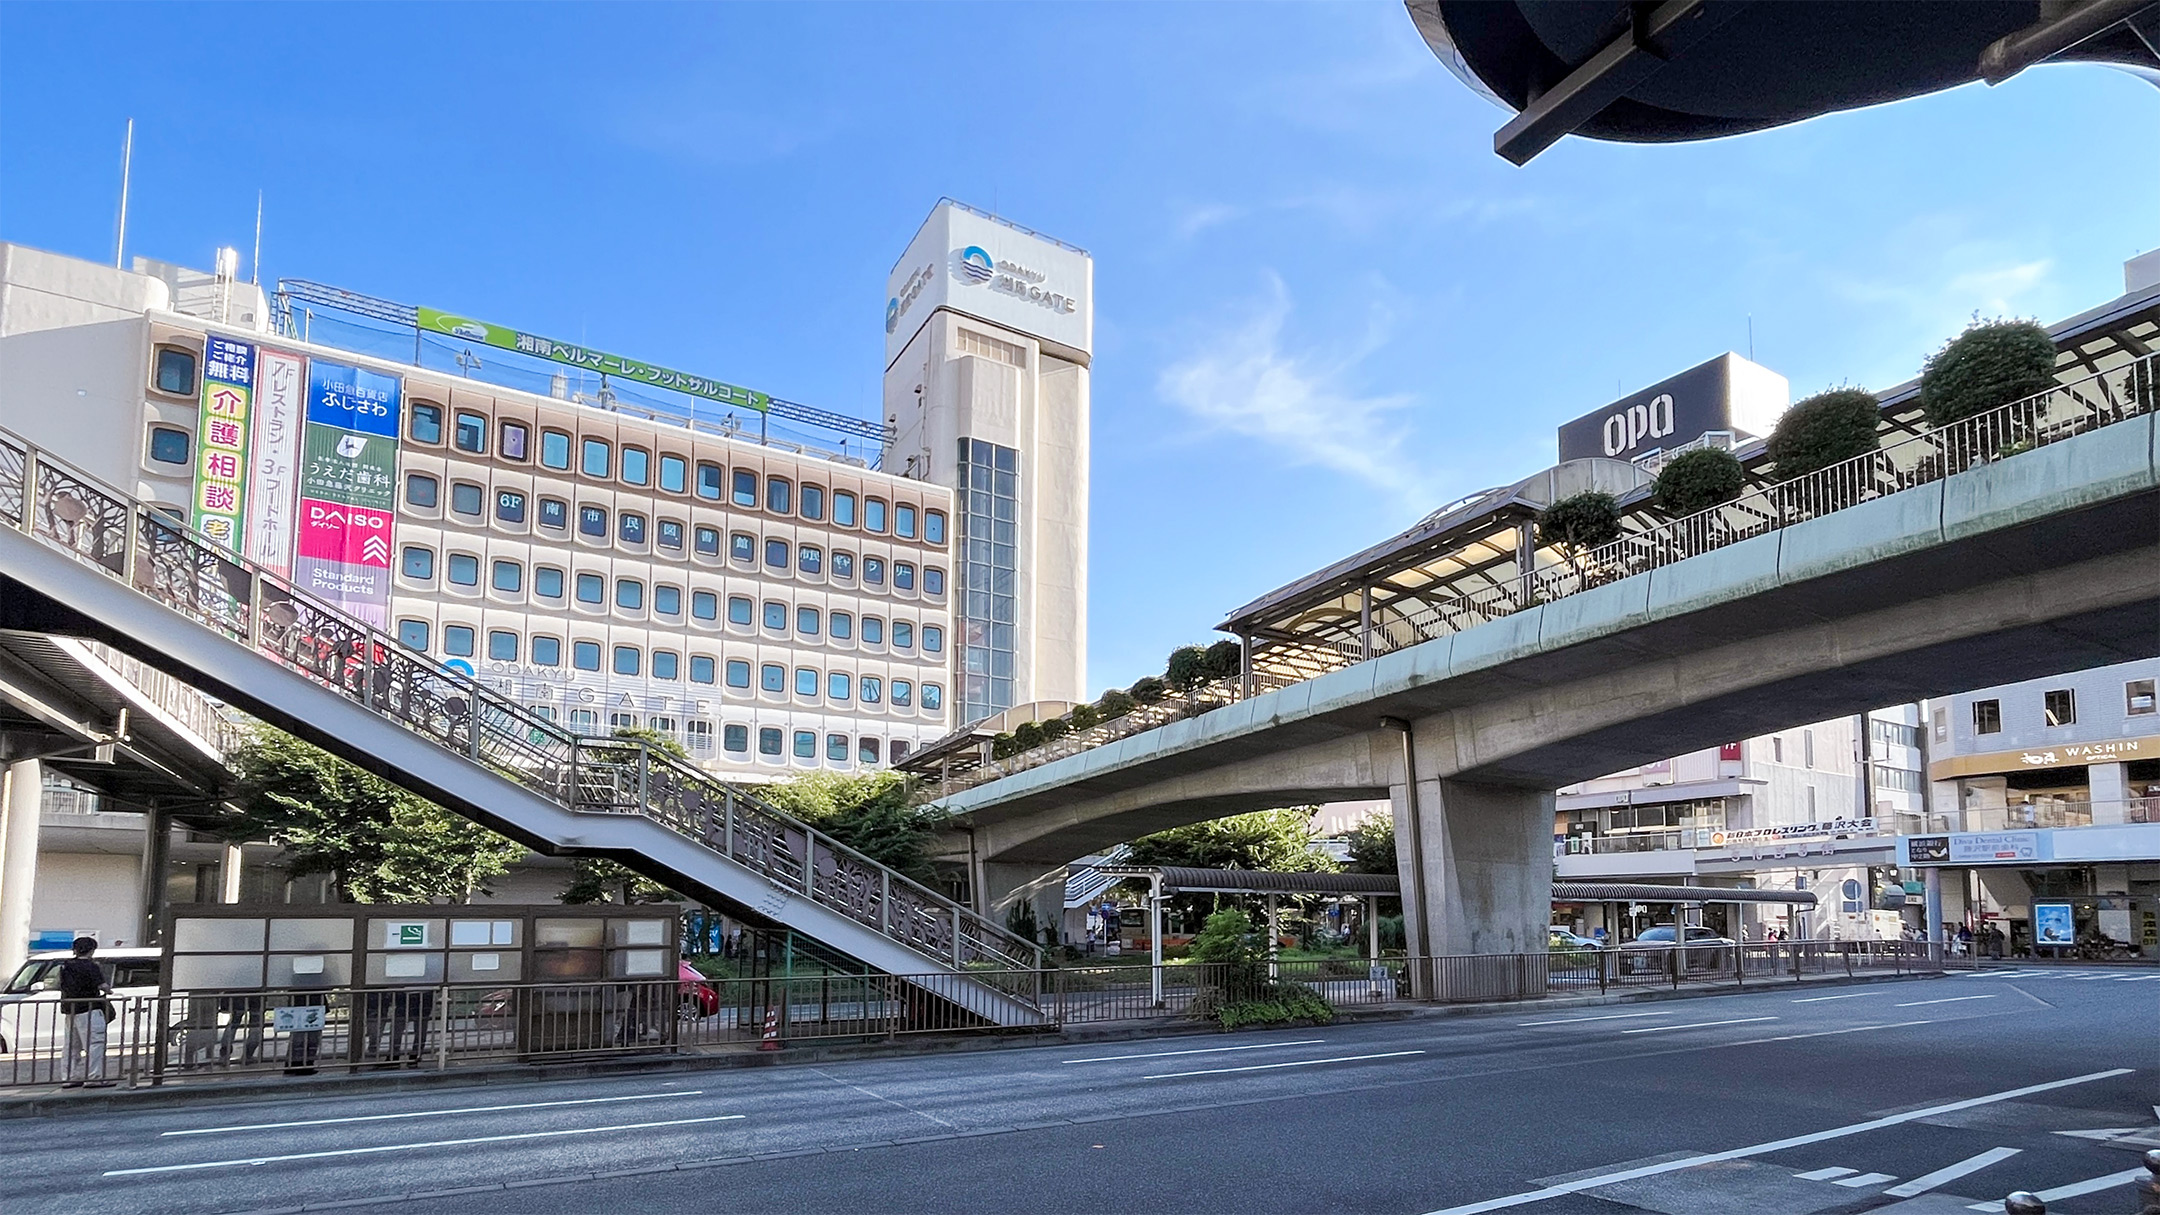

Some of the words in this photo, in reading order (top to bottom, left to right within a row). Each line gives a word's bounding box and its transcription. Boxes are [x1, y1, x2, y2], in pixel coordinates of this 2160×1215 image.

[208, 360, 250, 383] 無料
[516, 333, 760, 405] 湘南ベルマーレ・フットサルコート
[322, 377, 388, 402] 小田急百貨店
[322, 392, 388, 417] ふじさわ
[205, 389, 242, 512] 介護相談
[310, 462, 391, 489] うえだ歯科
[500, 494, 522, 508] 6F
[311, 506, 383, 529] DAISO
[312, 579, 374, 595] Products
[313, 568, 374, 585] Standard
[491, 662, 576, 682] ODAKYU
[2065, 741, 2139, 757] WASHIN
[2086, 753, 2117, 761] OPTICAL
[1975, 836, 2002, 844] Dental
[2004, 835, 2029, 844] Clinic
